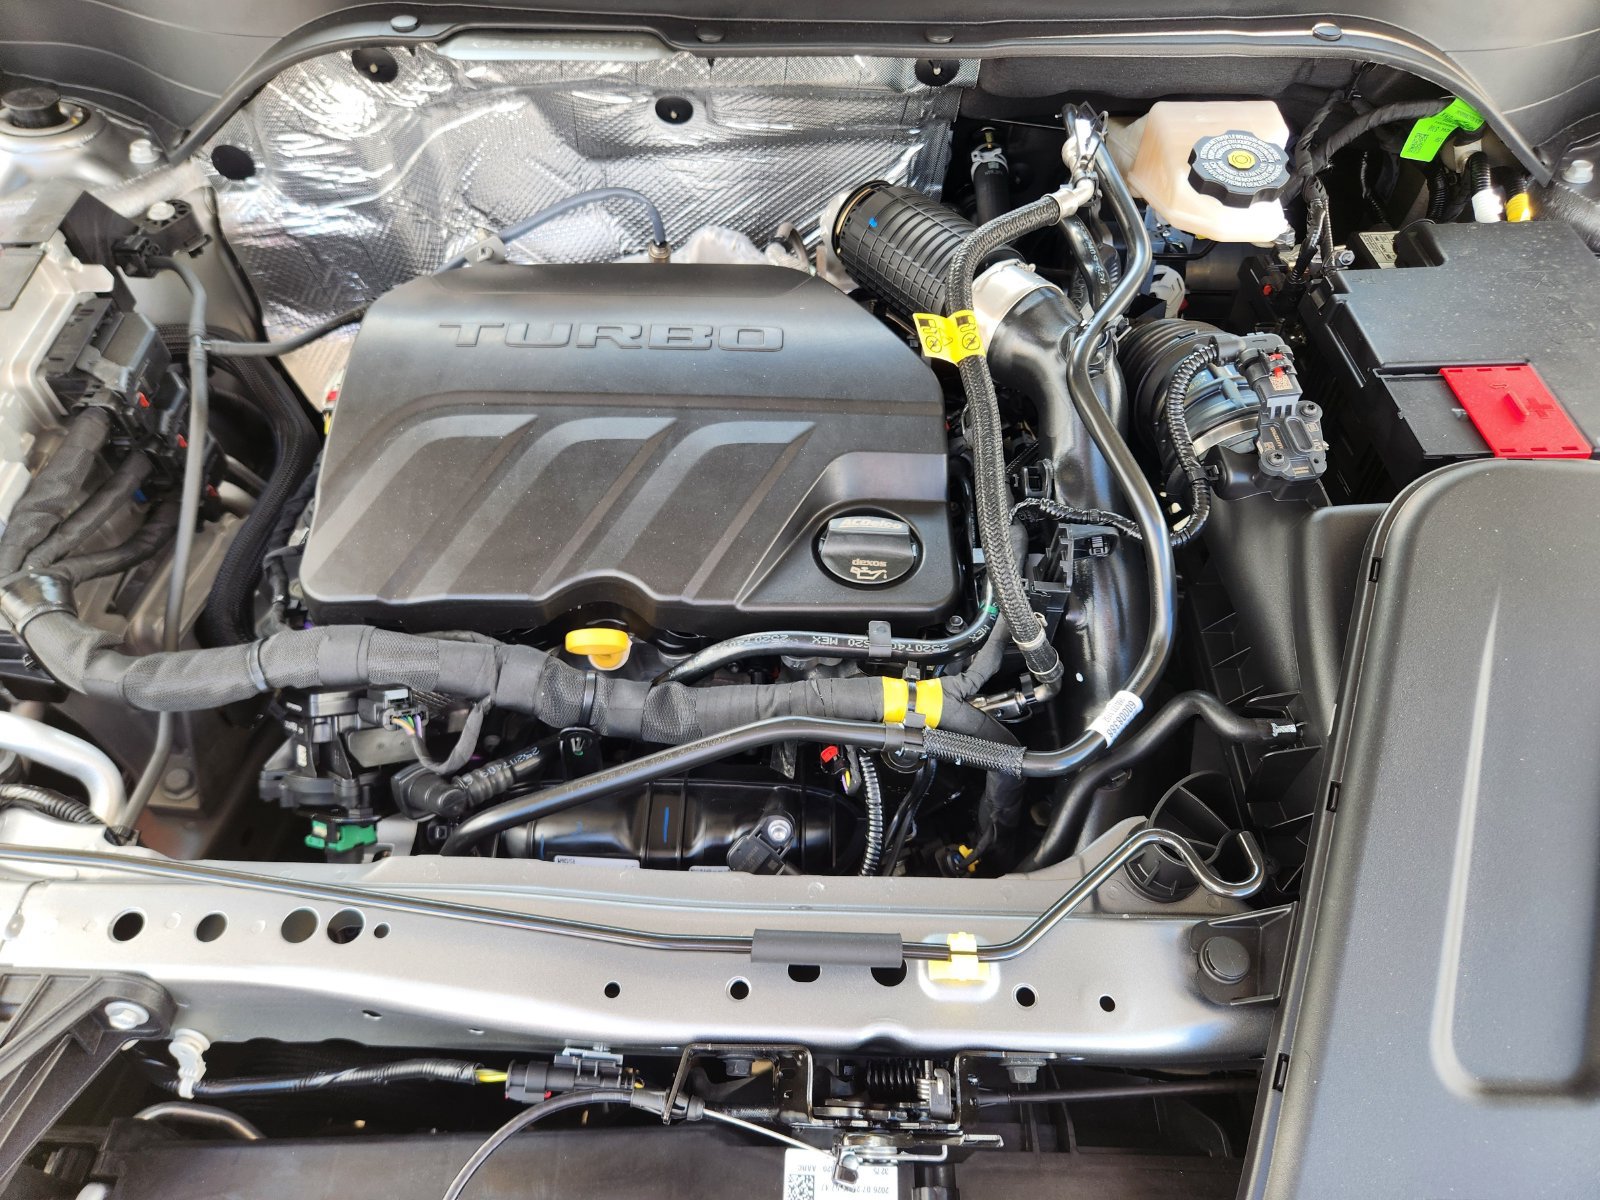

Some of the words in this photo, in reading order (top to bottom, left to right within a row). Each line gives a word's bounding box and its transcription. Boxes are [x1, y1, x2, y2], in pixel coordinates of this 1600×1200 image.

[440, 322, 784, 352] TURBO
[838, 518, 902, 529] ACDelco
[851, 558, 887, 567] dexos
[812, 635, 838, 646] MEX
[891, 642, 949, 652] 2520740
